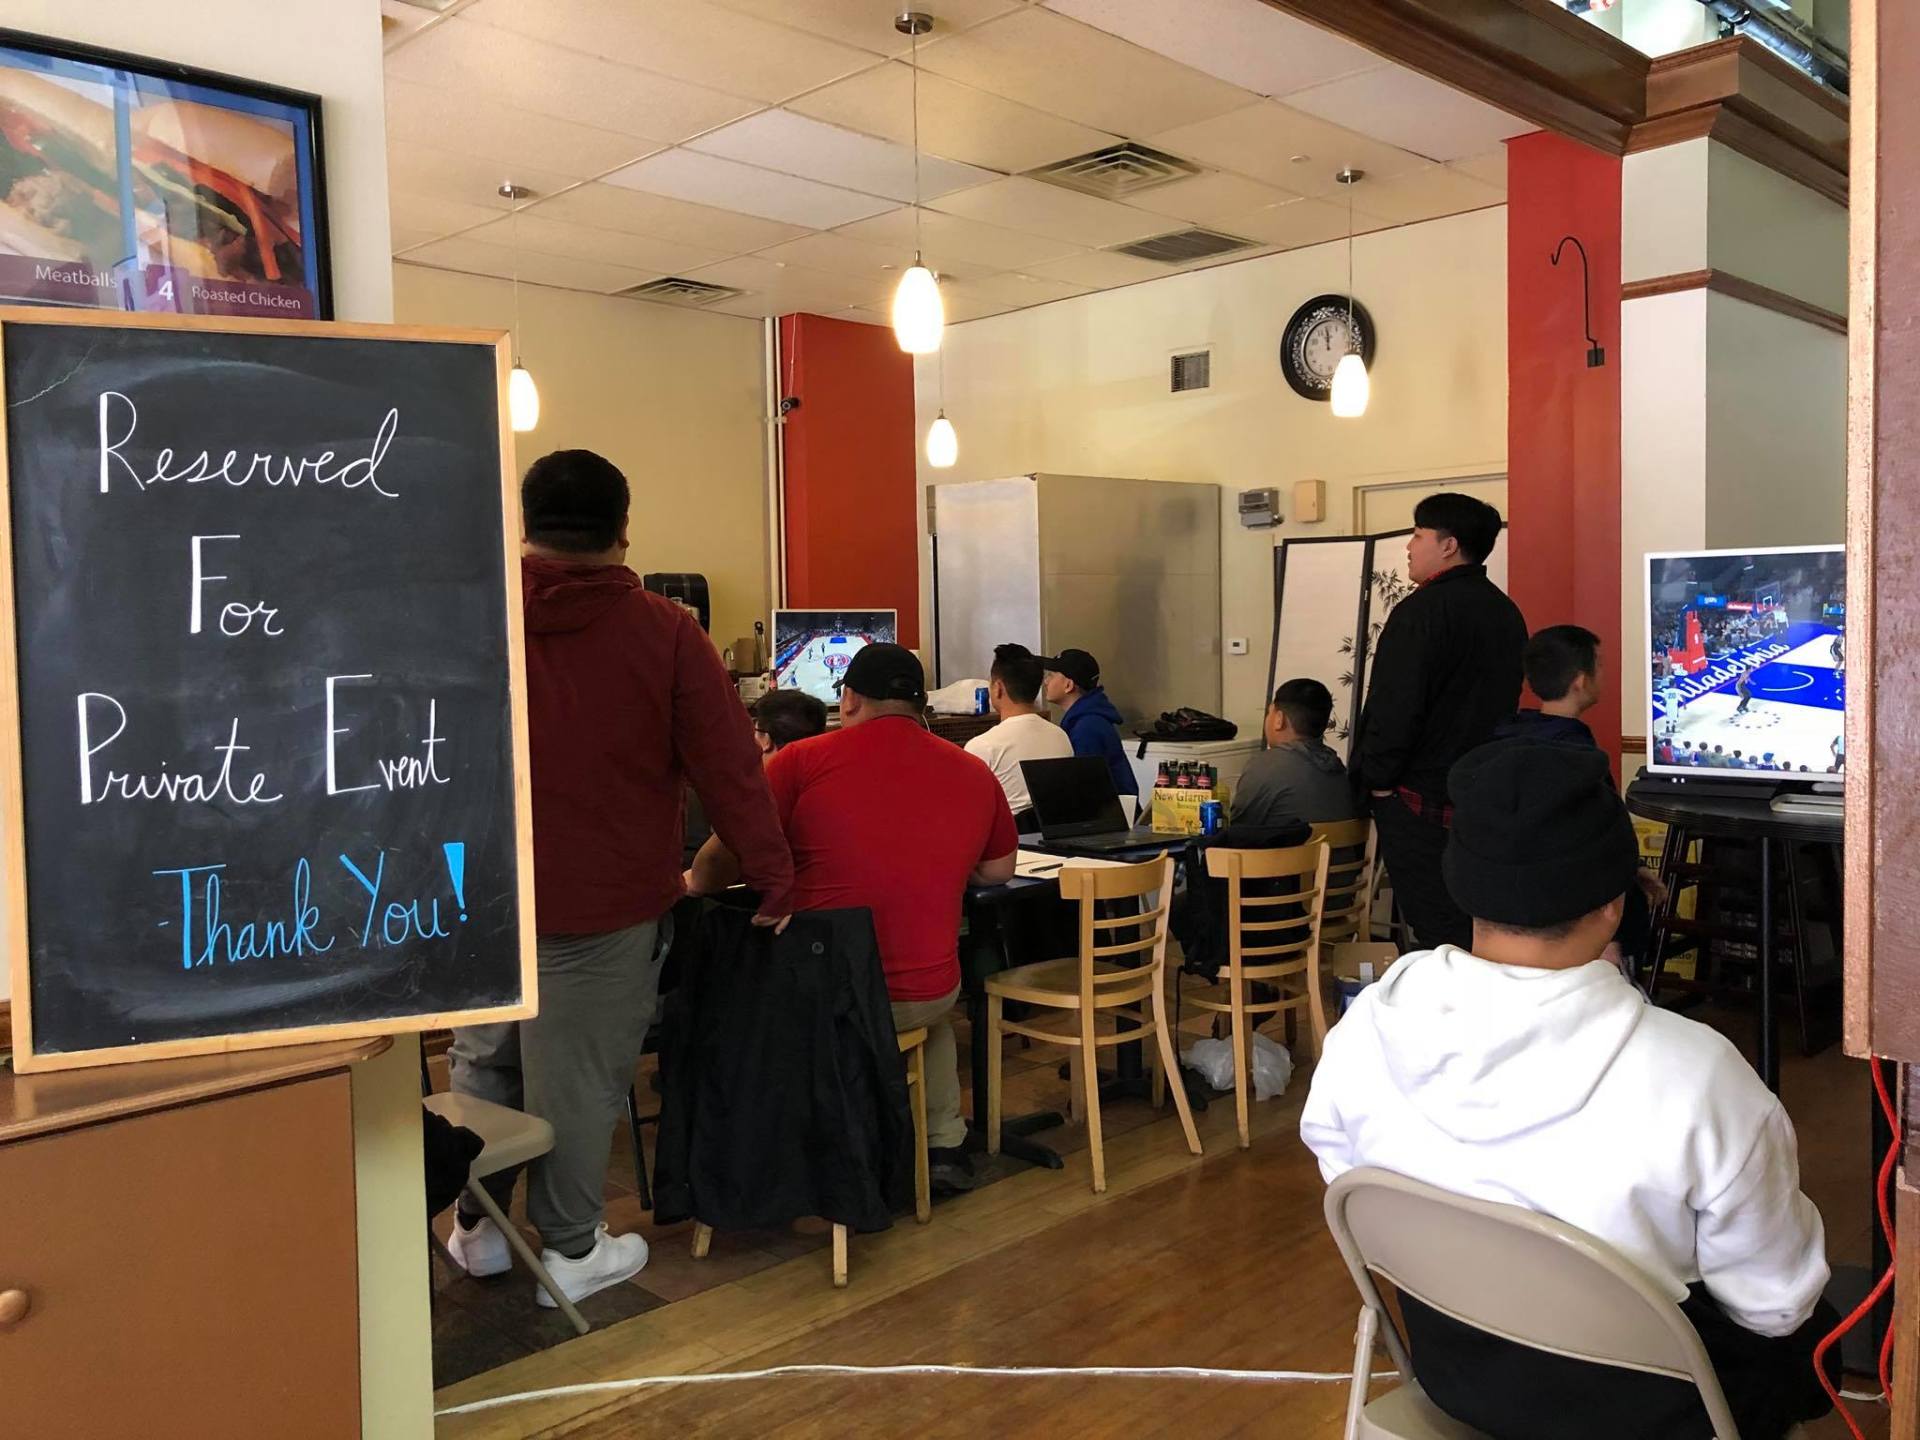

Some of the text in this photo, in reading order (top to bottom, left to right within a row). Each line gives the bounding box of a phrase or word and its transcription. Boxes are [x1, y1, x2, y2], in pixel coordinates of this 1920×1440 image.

[35, 264, 117, 289] Meatballs
[158, 280, 301, 309] 4 Roasted Chicken
[100, 391, 400, 497] Reserved
[190, 534, 284, 636] For
[77, 674, 450, 804] Private Event
[1154, 789, 1174, 801] New
[340, 842, 469, 947] You!
